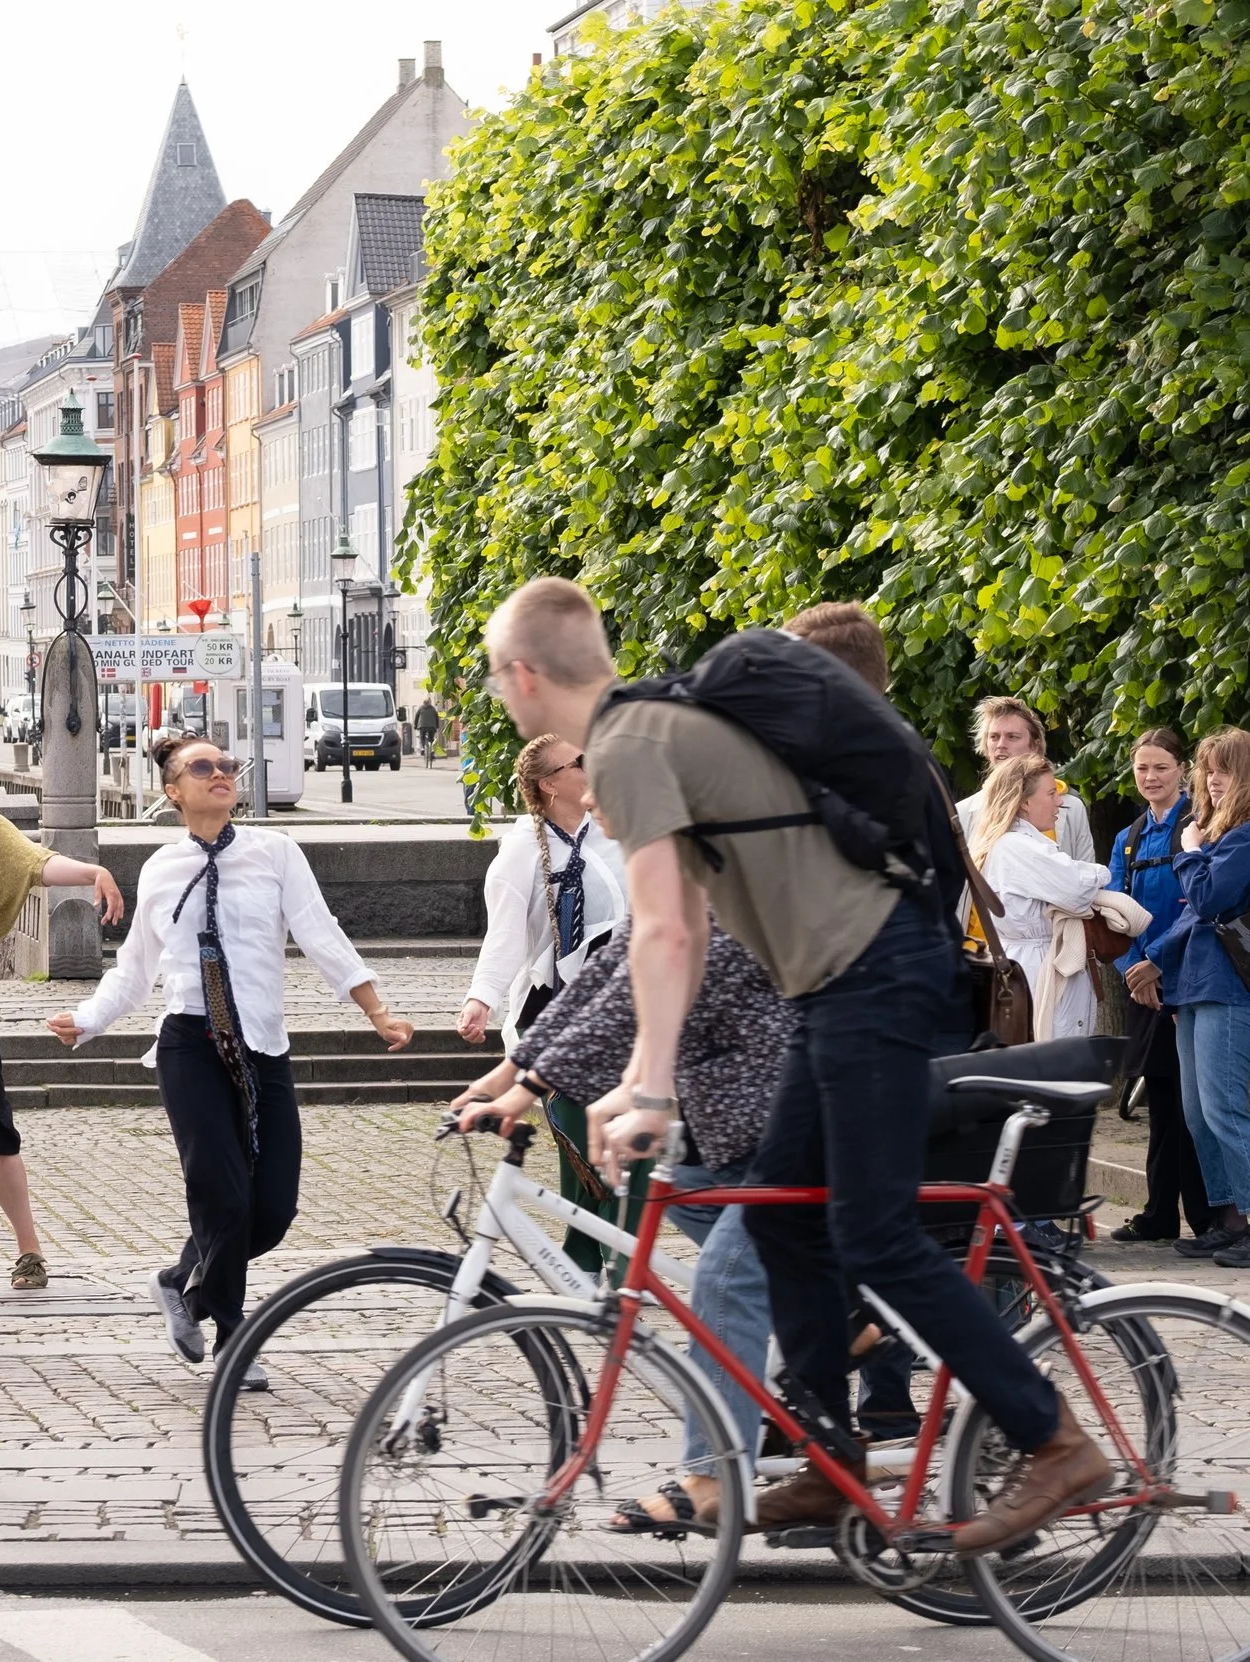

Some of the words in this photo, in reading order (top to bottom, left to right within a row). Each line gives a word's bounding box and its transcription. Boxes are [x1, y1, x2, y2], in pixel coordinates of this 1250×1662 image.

[206, 643, 217, 651] 50
[219, 643, 233, 651] KR
[100, 659, 120, 667] MIN
[123, 658, 162, 667] GUDED
[166, 658, 194, 666] TOUR
[204, 657, 215, 665] 20
[218, 657, 233, 665] KR
